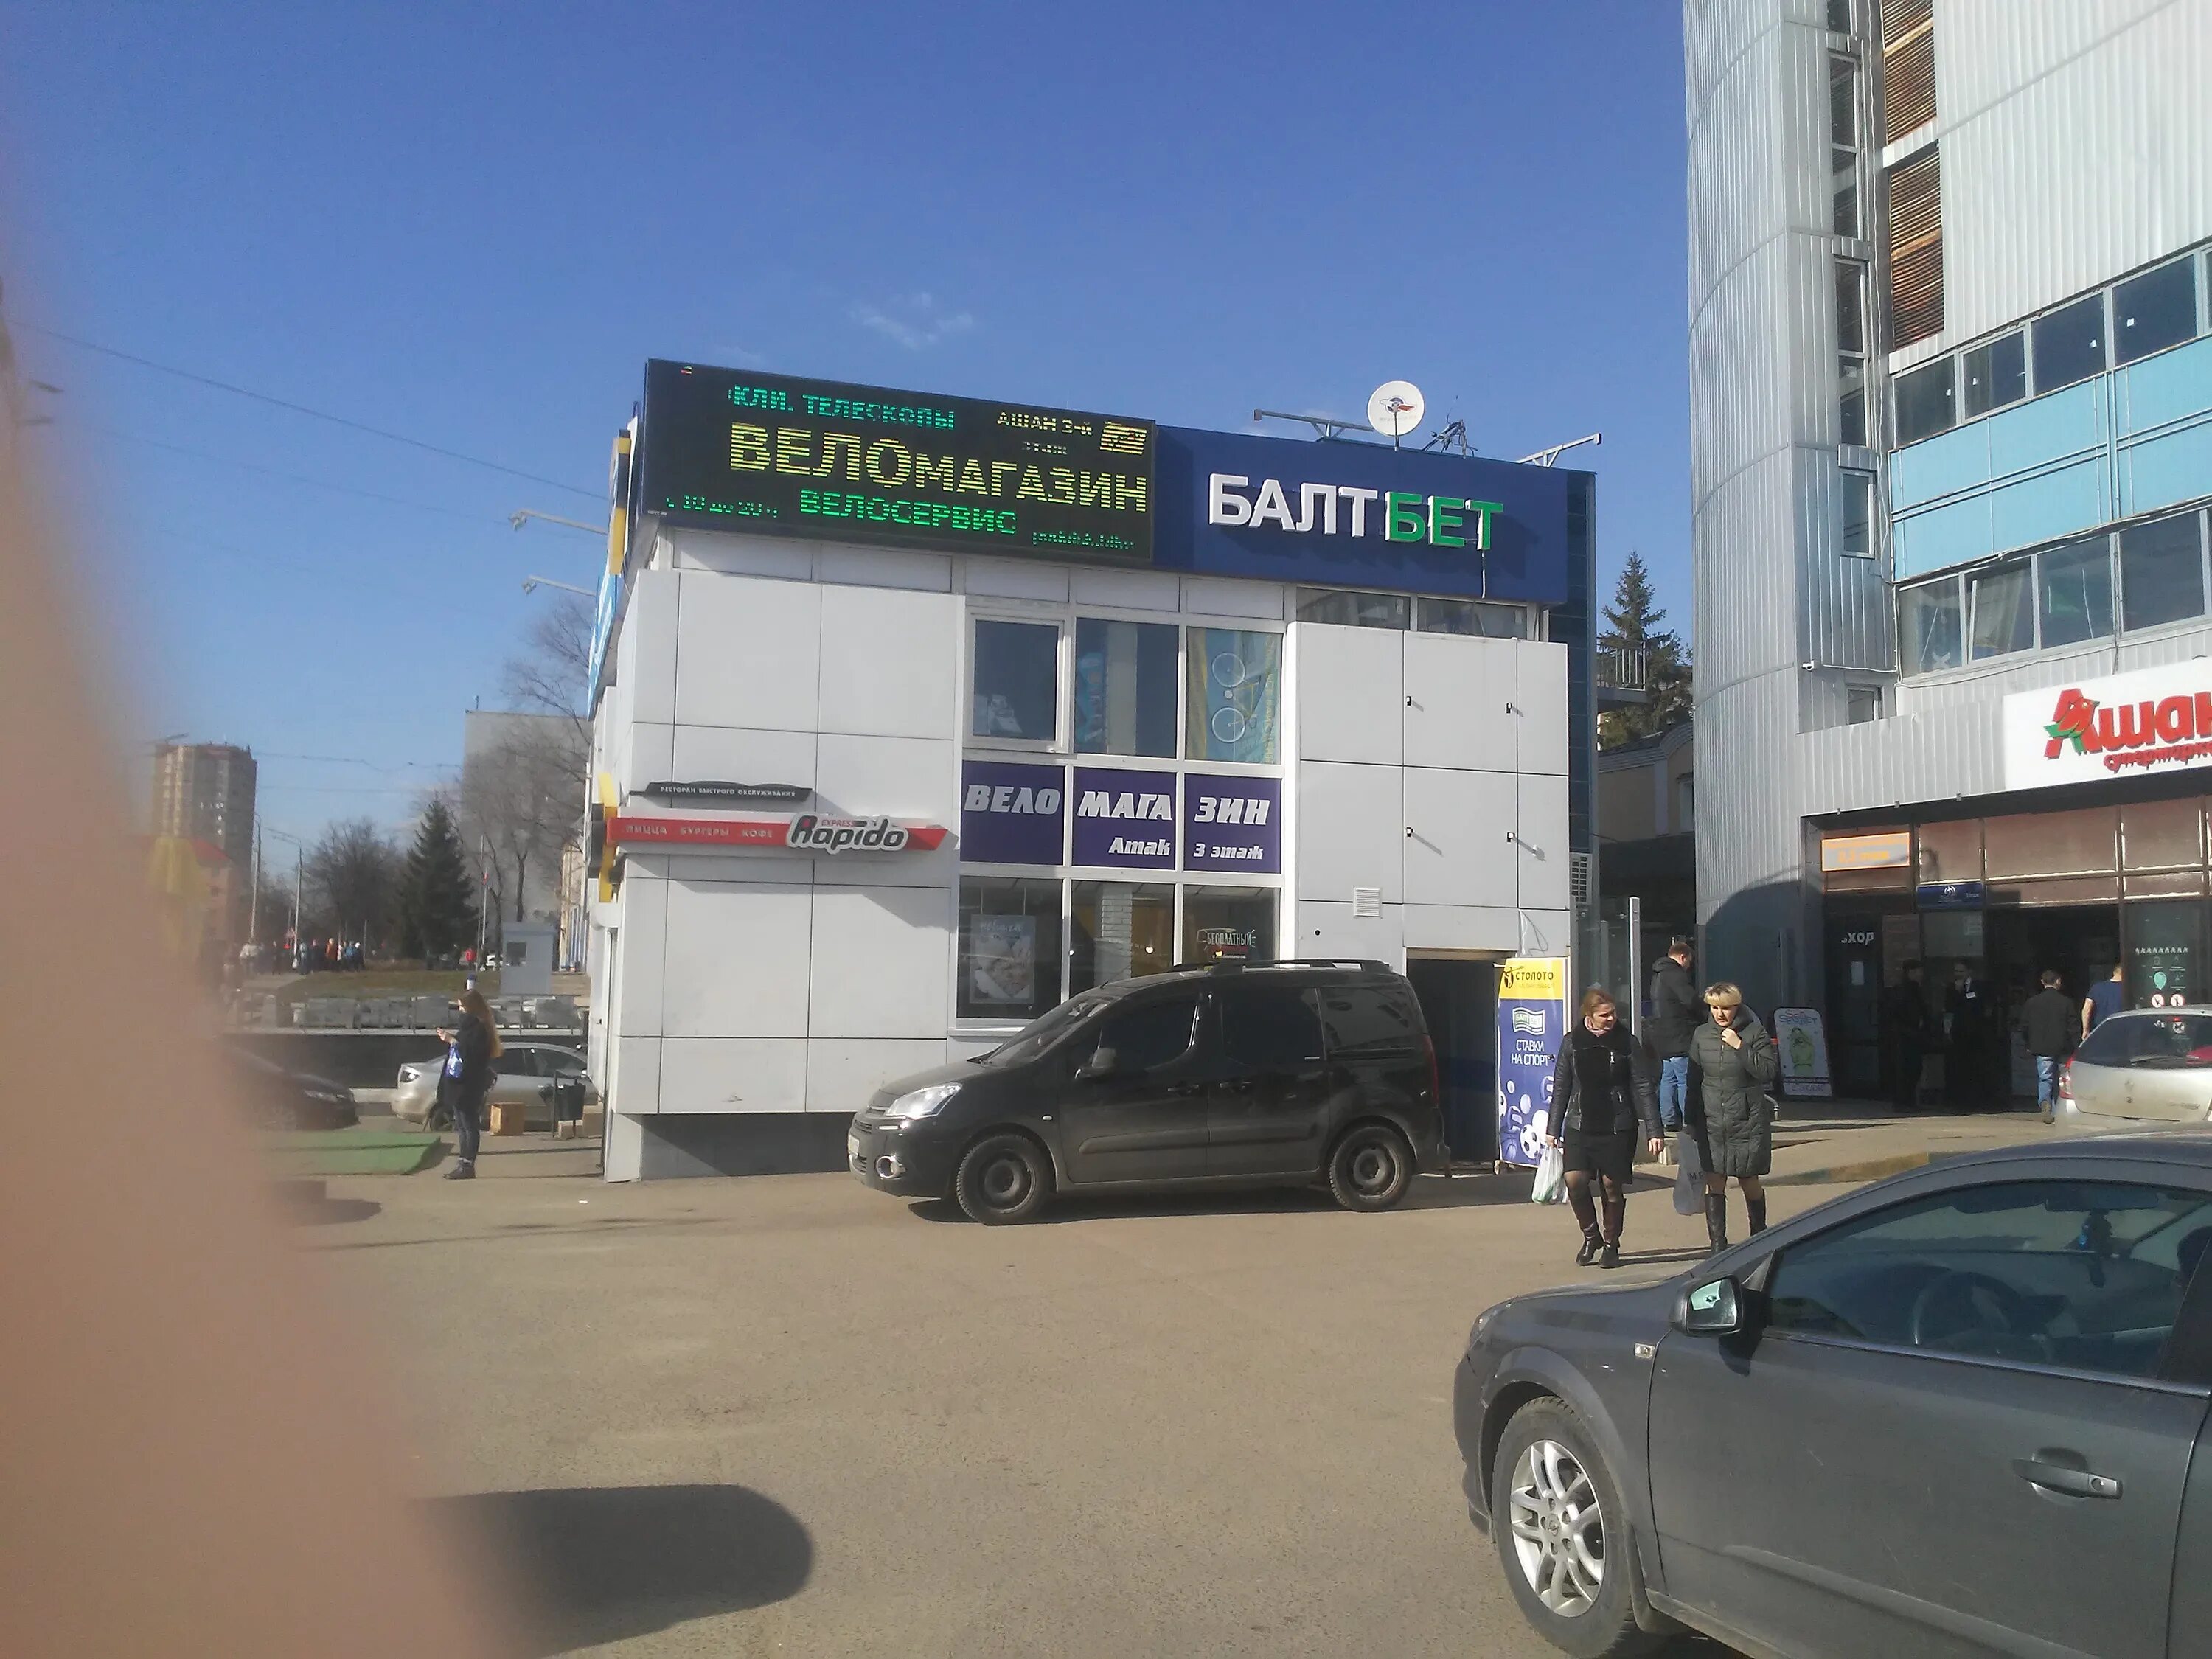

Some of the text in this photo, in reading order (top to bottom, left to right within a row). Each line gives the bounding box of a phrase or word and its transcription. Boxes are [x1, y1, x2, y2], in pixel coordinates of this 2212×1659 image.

[728, 385, 954, 430] КЛИ. ТЕЛЕСКОПЫ
[997, 411, 1057, 431] АШАН
[730, 422, 1147, 512] ВЕЛОМАГАЗИН
[801, 490, 1016, 535] ВЕЛОСЕРВИС
[1209, 473, 1504, 550] БАЛТБЕТ
[737, 789, 796, 797] ОБСЛУЖИВАНИЯ
[964, 785, 1270, 826] ВЕЛО МАГА ЗИН
[627, 825, 773, 838] ПИЦЦА БУРГЕРЫ КОФЕ
[791, 815, 905, 850] Rapido
[1108, 837, 1172, 857] Атак
[1210, 845, 1264, 860] этаж
[1207, 931, 1251, 945] БЕСПЛАТНЫЙ
[1515, 971, 1554, 981] СТОЛОТО
[1516, 1039, 1545, 1052] СТАВКИ
[1511, 1053, 1548, 1067] НА СПОРТ
